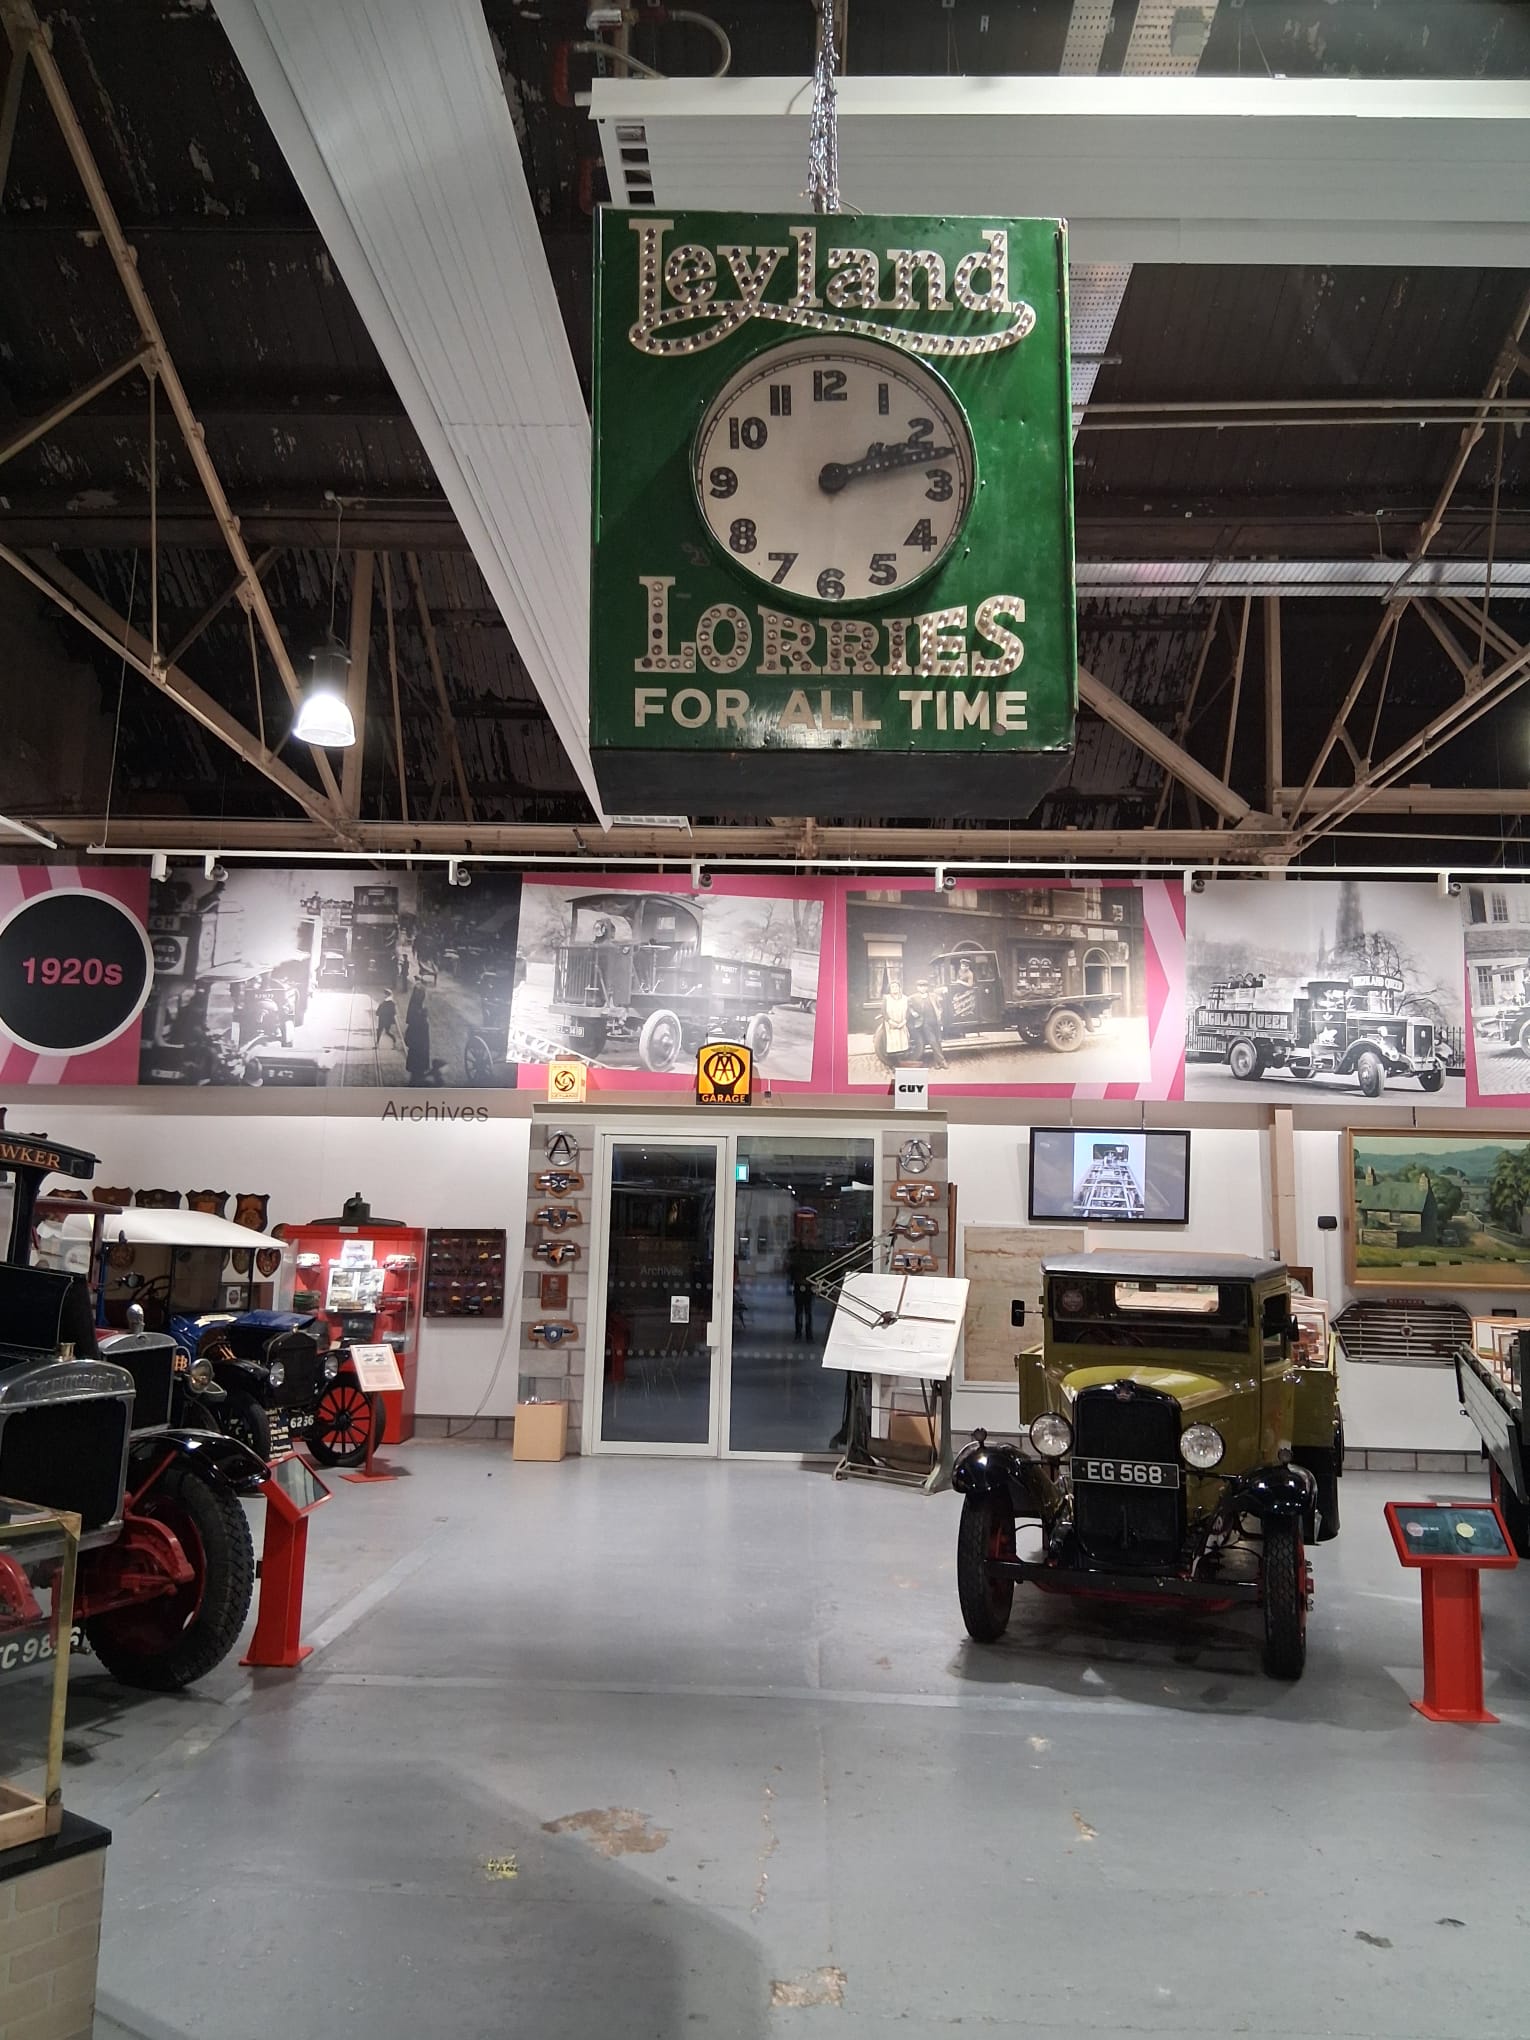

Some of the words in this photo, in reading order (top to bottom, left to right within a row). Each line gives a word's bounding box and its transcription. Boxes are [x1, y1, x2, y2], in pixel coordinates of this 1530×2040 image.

[628, 218, 1037, 355] Leyland
[770, 384, 792, 417] 11
[813, 370, 848, 402] 12
[878, 383, 889, 415] 1
[729, 417, 768, 450] 10
[907, 418, 935, 447] 2
[709, 466, 739, 499] 9
[925, 468, 954, 502] 3
[729, 518, 758, 554] 8
[903, 518, 938, 552] 4
[768, 552, 798, 584] 7
[816, 568, 846, 600] 6
[868, 553, 898, 586] 5
[634, 576, 1027, 678] LORRIES
[634, 688, 751, 729] FOR
[777, 690, 882, 731] ALL
[898, 691, 1028, 731] TIME
[22, 957, 123, 985] 1920s
[701, 1094, 746, 1103] GARAGE
[898, 1084, 924, 1093] GUY
[382, 1100, 489, 1122] Archives
[1087, 1461, 1115, 1481] EG
[1120, 1463, 1162, 1484] 568
